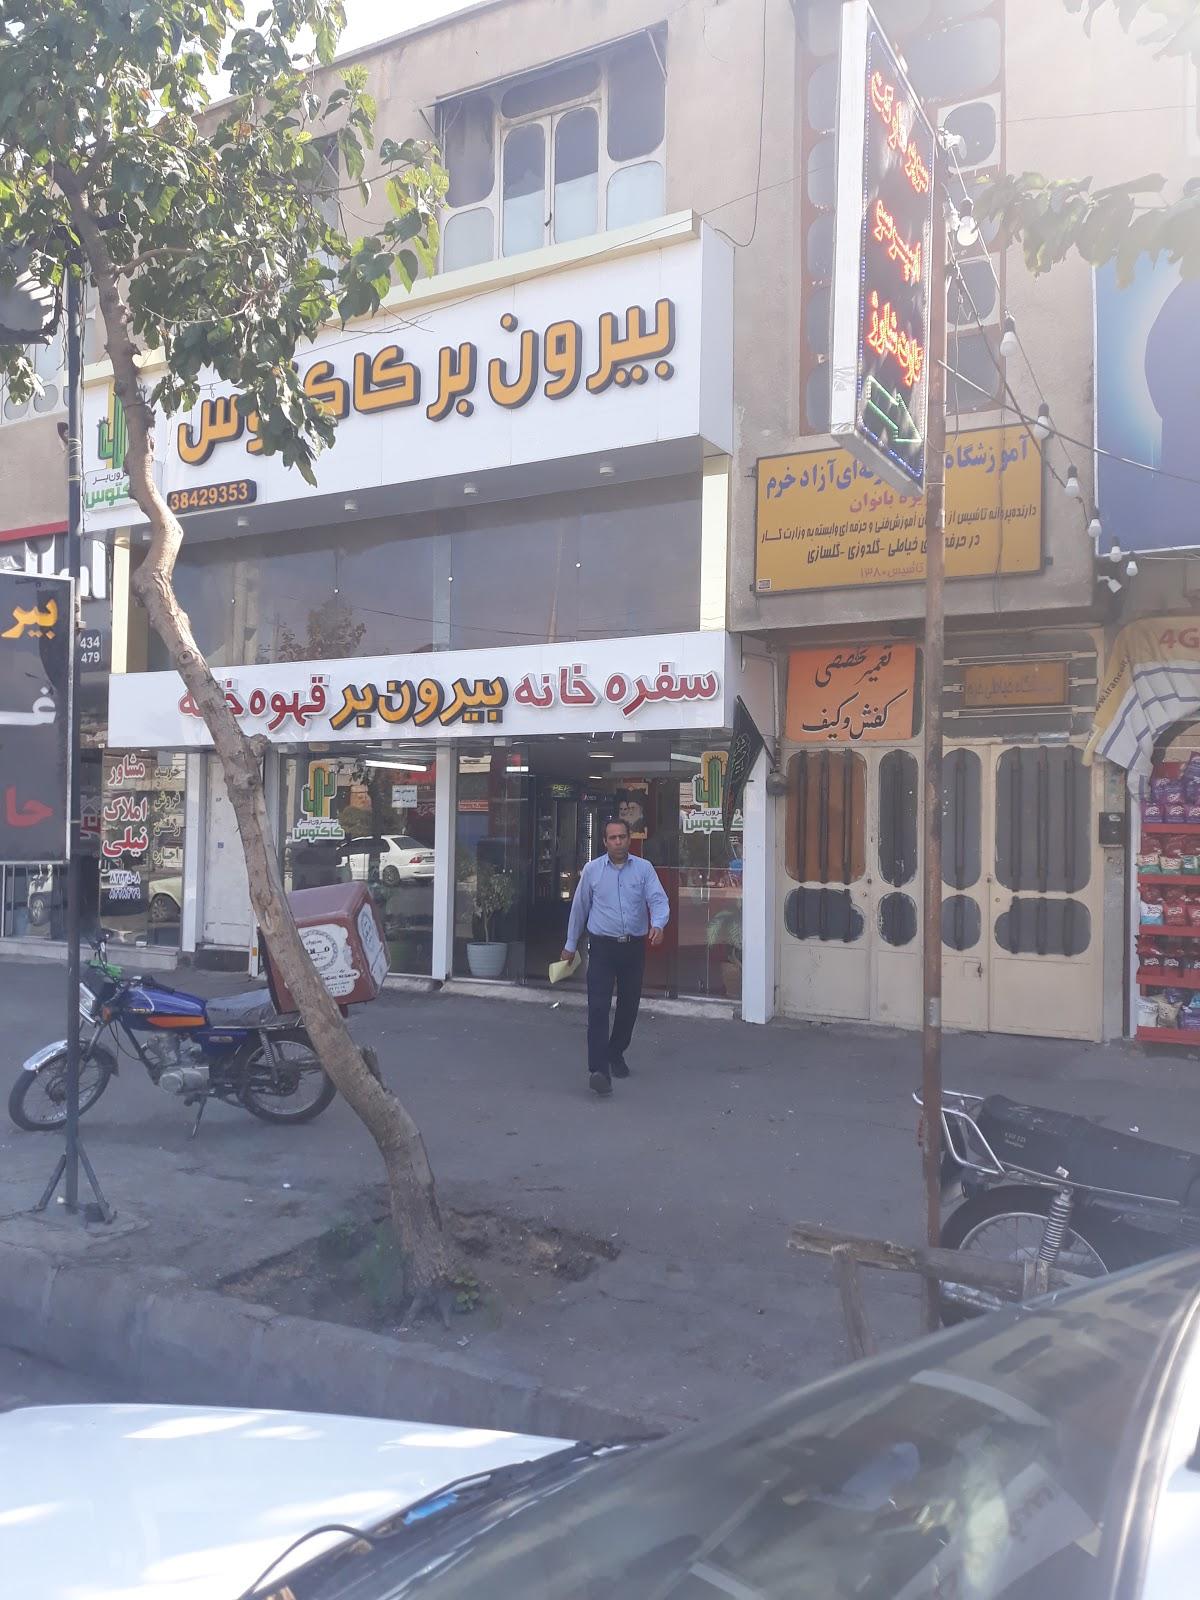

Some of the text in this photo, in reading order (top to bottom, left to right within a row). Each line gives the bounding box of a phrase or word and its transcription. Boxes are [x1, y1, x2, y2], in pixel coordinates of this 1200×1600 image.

[488, 297, 676, 411] بیرون
[426, 342, 477, 423] بر
[945, 432, 1032, 474] آموزشگاه
[170, 481, 249, 511] 38429353
[766, 465, 798, 500] خرم
[849, 490, 894, 513] بانوان
[888, 536, 919, 558] خیاطی
[967, 533, 981, 549] در
[249, 673, 331, 733] قهوه
[378, 675, 509, 728] بیرون
[513, 662, 600, 709] خانه
[604, 661, 720, 720] سفره
[329, 682, 378, 731] بر
[800, 688, 909, 740] کفش و کیف
[107, 753, 146, 787] مشاور
[103, 796, 148, 823] املاک
[102, 825, 150, 858] نیلی
[294, 826, 344, 842] کاکتوس
